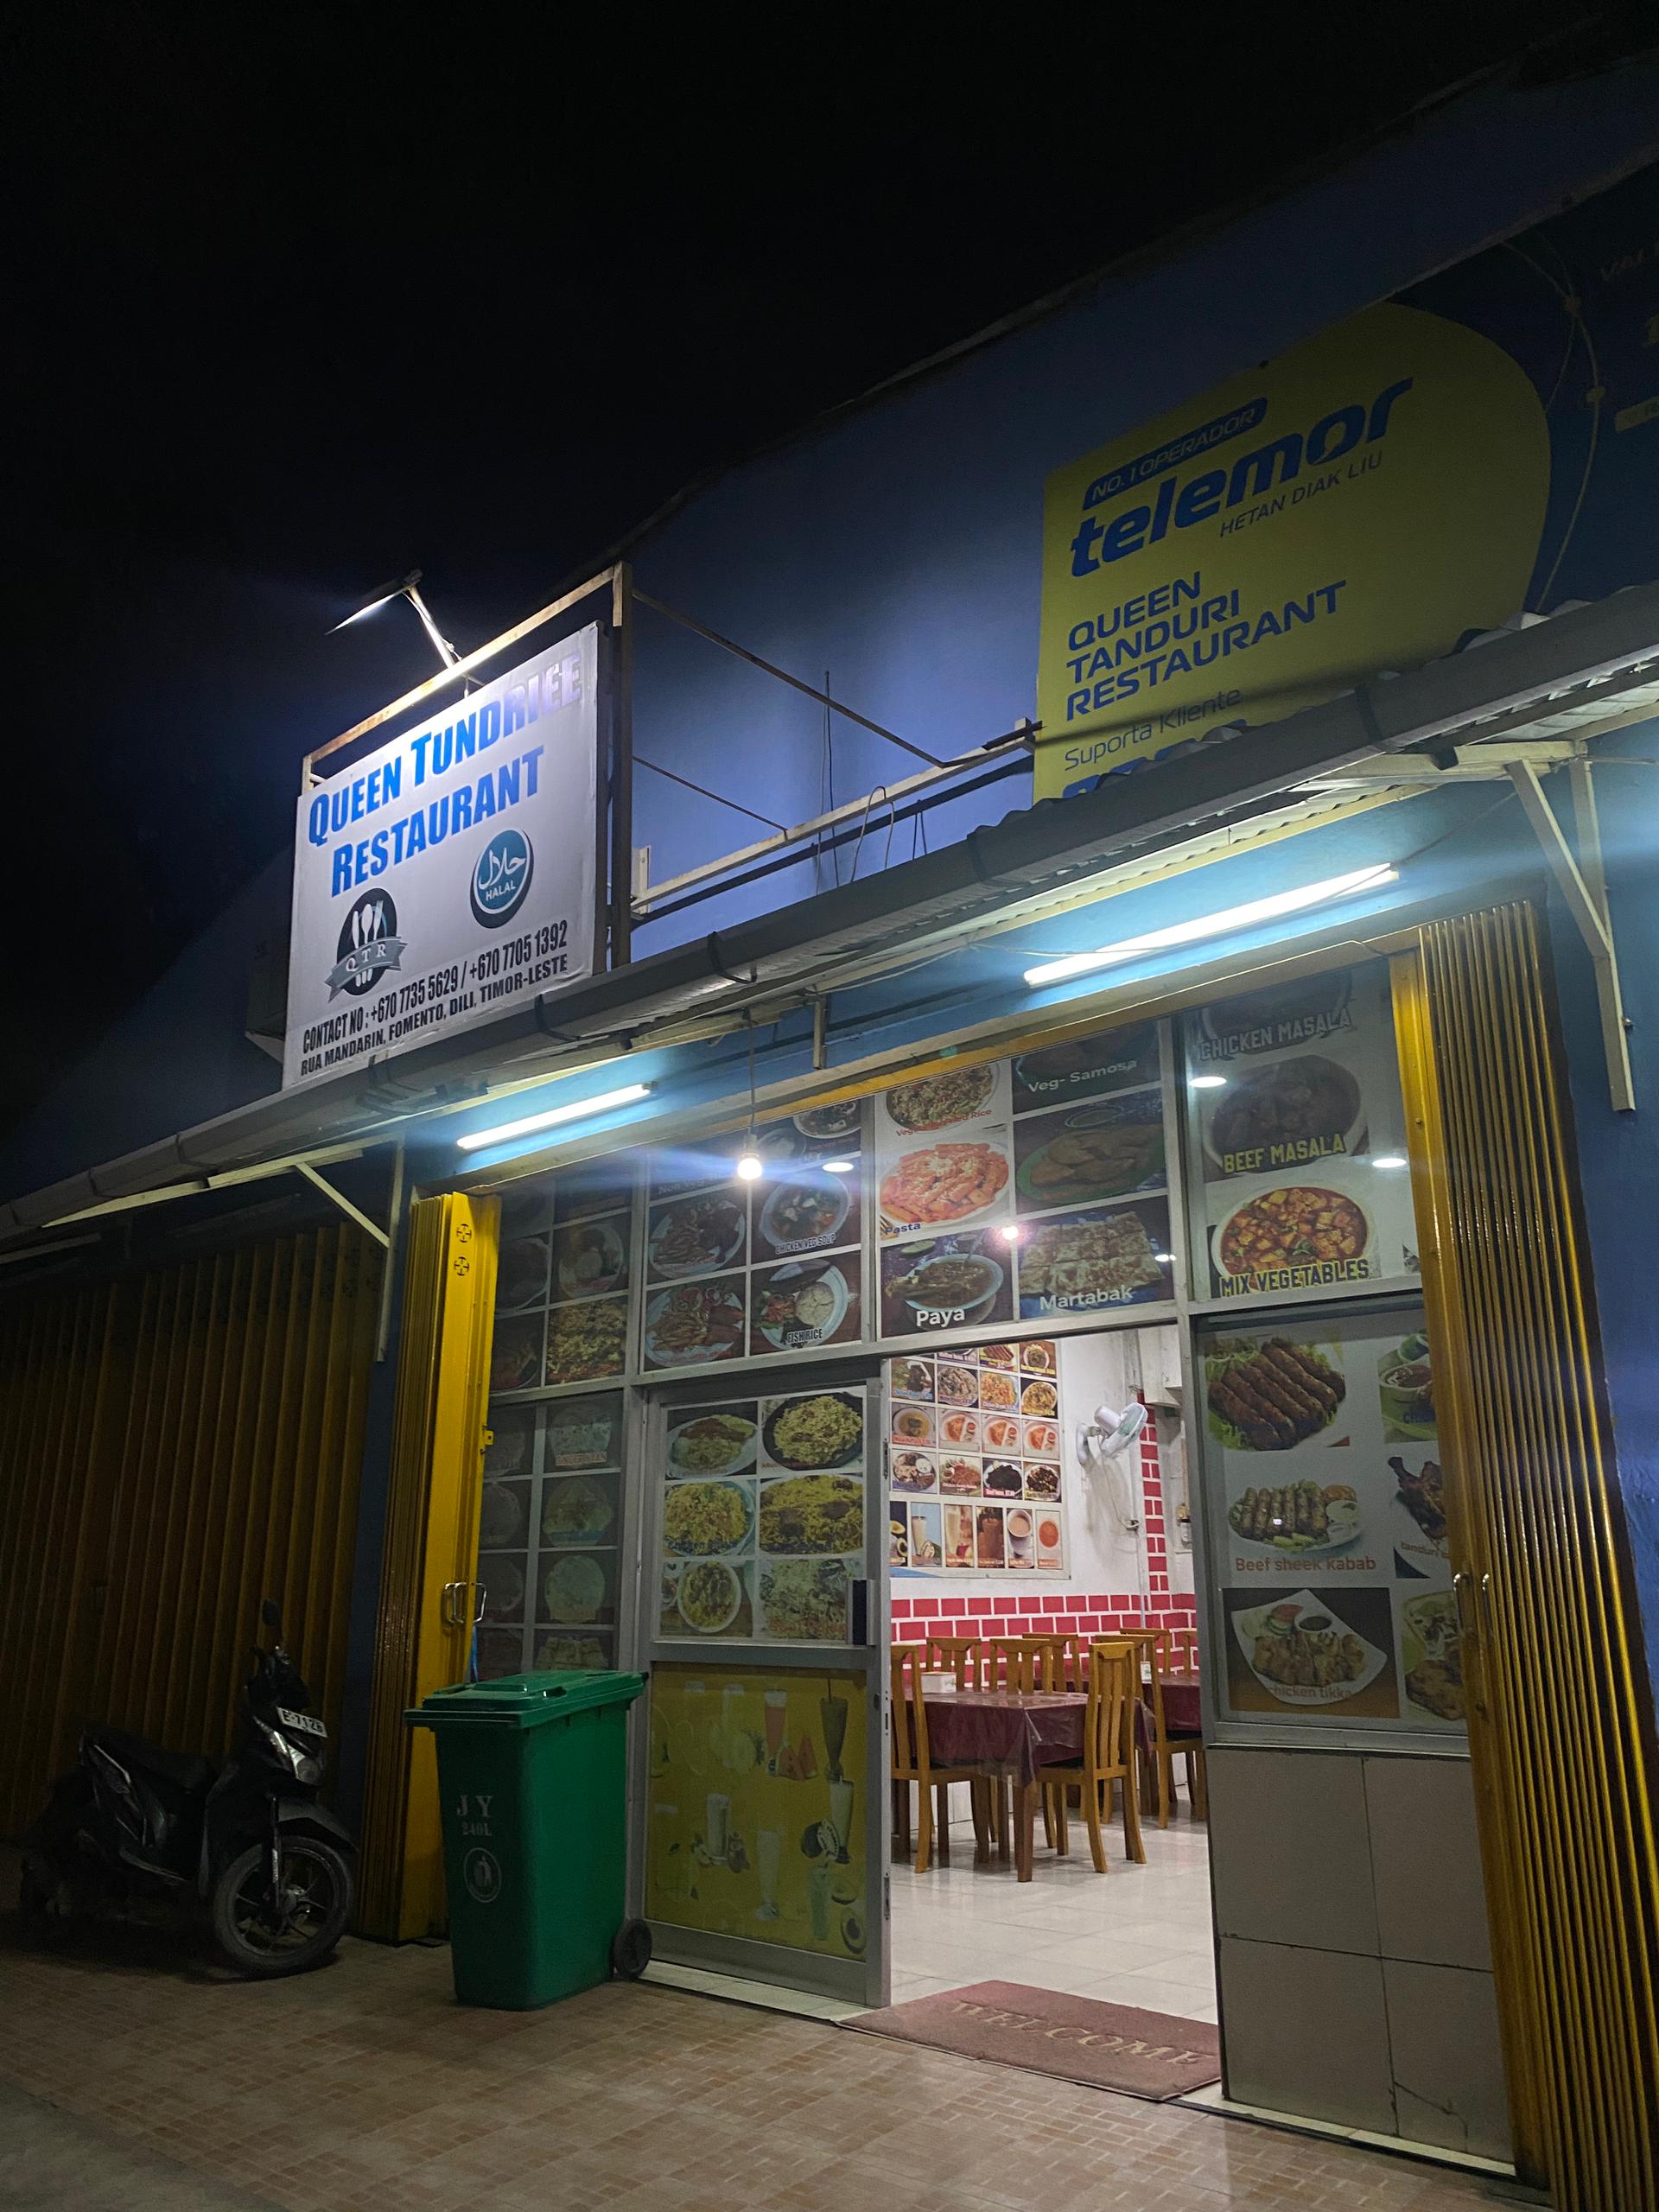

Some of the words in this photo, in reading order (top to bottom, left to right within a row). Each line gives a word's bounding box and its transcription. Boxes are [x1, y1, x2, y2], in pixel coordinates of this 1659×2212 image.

[1070, 377, 1414, 577] telemor
[1219, 493, 1286, 537] HETAN
[1291, 469, 1340, 505] DIAK
[1347, 449, 1382, 480] LIU
[1068, 571, 1201, 651] QUEEN
[1066, 589, 1240, 685] TANDURI
[1066, 580, 1347, 721] RESTAURANT
[1064, 720, 1152, 772] Suporta
[1159, 689, 1243, 734] Kliente
[308, 756, 402, 847] QUEEN
[331, 744, 544, 898] RESTAURANT
[478, 847, 527, 891] حلال
[485, 880, 517, 902] HALAL
[302, 1013, 347, 1054] CONTACT
[371, 992, 397, 1024] +670
[399, 978, 425, 1014] 7735
[428, 965, 459, 1001] 5629
[469, 947, 499, 982] +670
[502, 933, 531, 971] 7705
[534, 919, 568, 957] 1392
[301, 1052, 323, 1077] RUA
[479, 953, 568, 1003] TIMOR-LESTE
[1277, 1004, 1353, 1043] MASALA
[1070, 1058, 1138, 1084] Samosa
[1224, 1149, 1266, 1174] BEEF
[1270, 1133, 1346, 1166] MASALA
[817, 1232, 837, 1246] SOUP
[884, 1222, 921, 1236] Pasta
[1039, 1284, 1134, 1312] Martabak
[1219, 1273, 1252, 1299] MIX
[1256, 1257, 1370, 1293] VEGETABLES
[787, 1331, 805, 1344] FISH
[806, 1328, 823, 1341] RICE
[915, 1307, 966, 1328] Paya
[1236, 1557, 1272, 1572] Beef
[1274, 1557, 1323, 1572] sheek
[950, 2001, 1215, 2065] WELCOME
